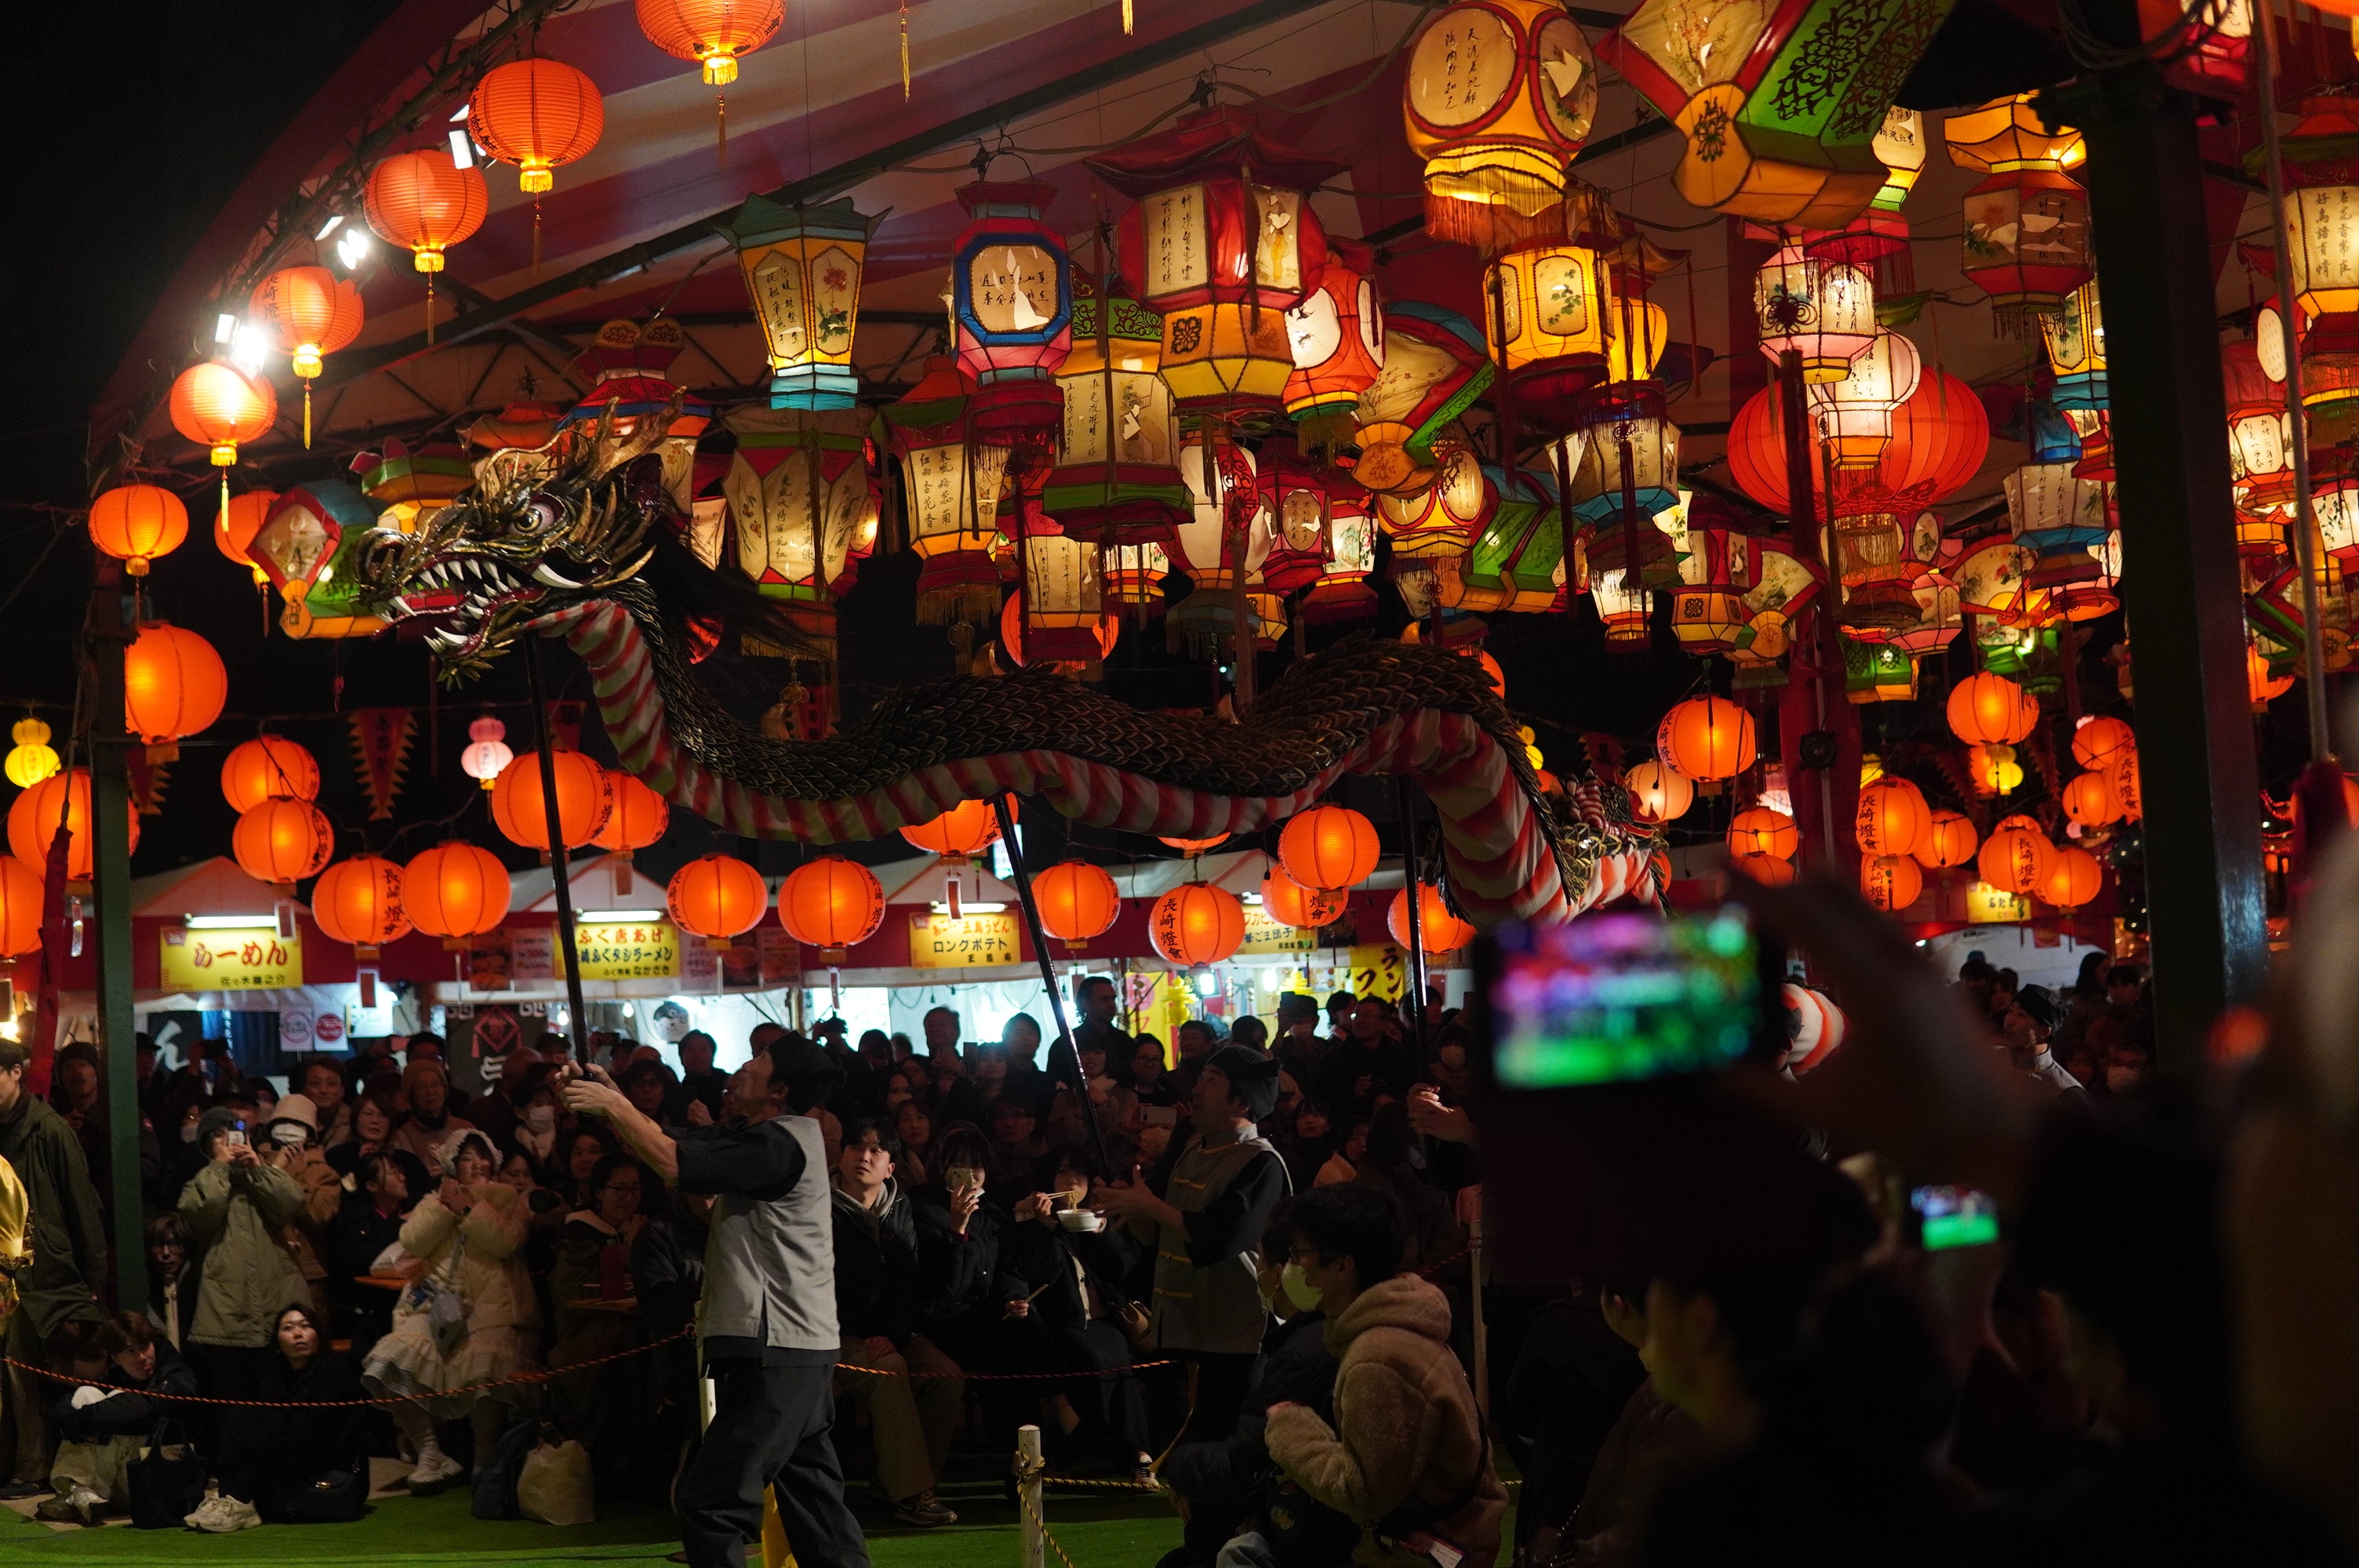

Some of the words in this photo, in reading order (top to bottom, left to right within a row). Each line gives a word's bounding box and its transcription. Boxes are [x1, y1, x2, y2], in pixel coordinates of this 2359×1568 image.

[1858, 794, 1878, 850] 長崎燈會
[2018, 837, 2036, 887] 長崎燈會
[933, 938, 1008, 953] ロングポテト
[1159, 898, 1183, 959] 長崎燈會
[194, 940, 287, 968] らーめん
